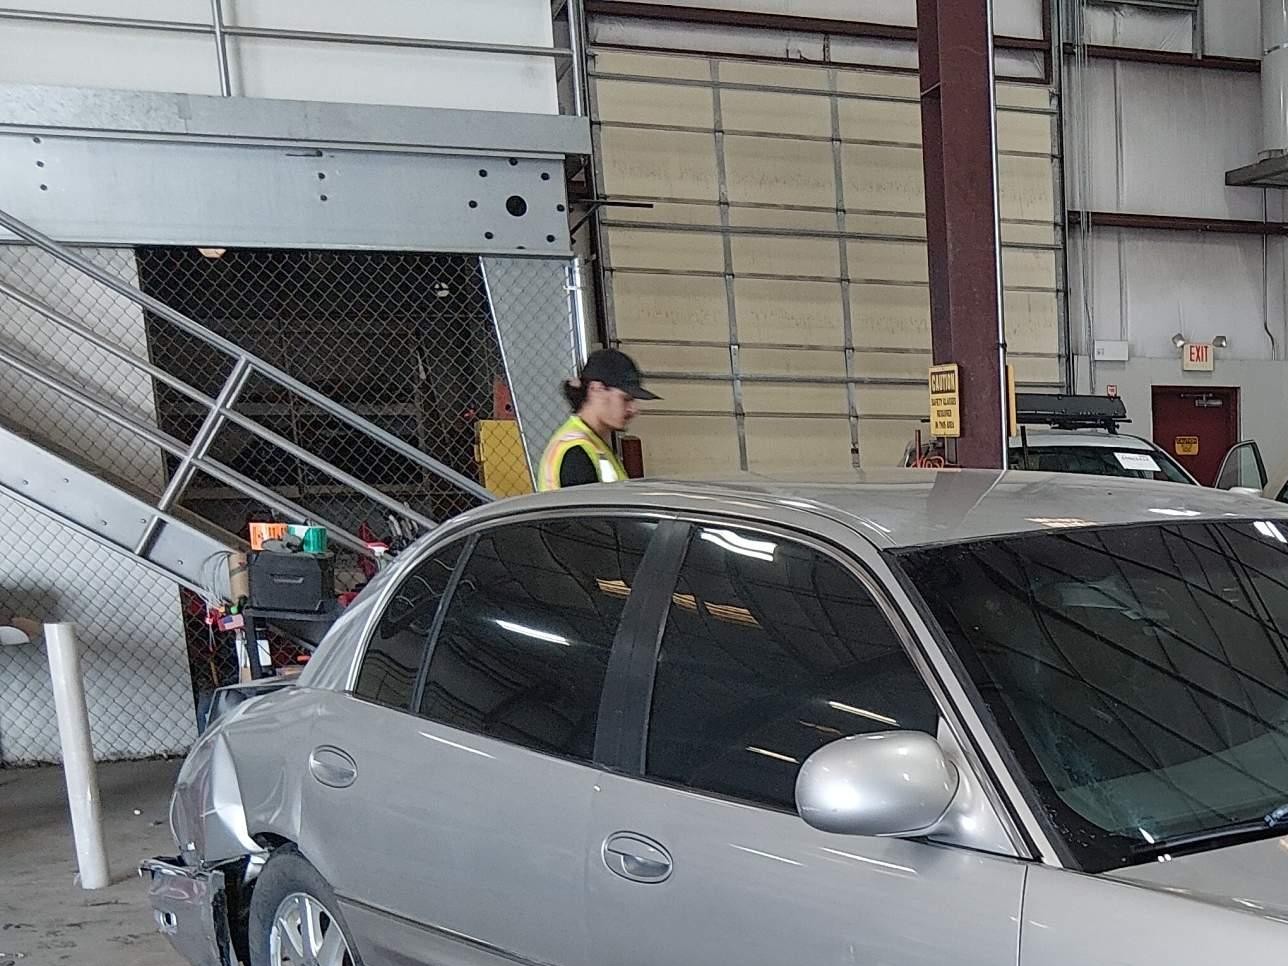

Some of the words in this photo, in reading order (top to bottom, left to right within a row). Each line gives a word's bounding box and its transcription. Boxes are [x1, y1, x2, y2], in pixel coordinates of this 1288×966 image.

[1189, 345, 1209, 362] EXIT
[931, 373, 955, 392] CAUTION
[931, 398, 942, 406] SAFETY
